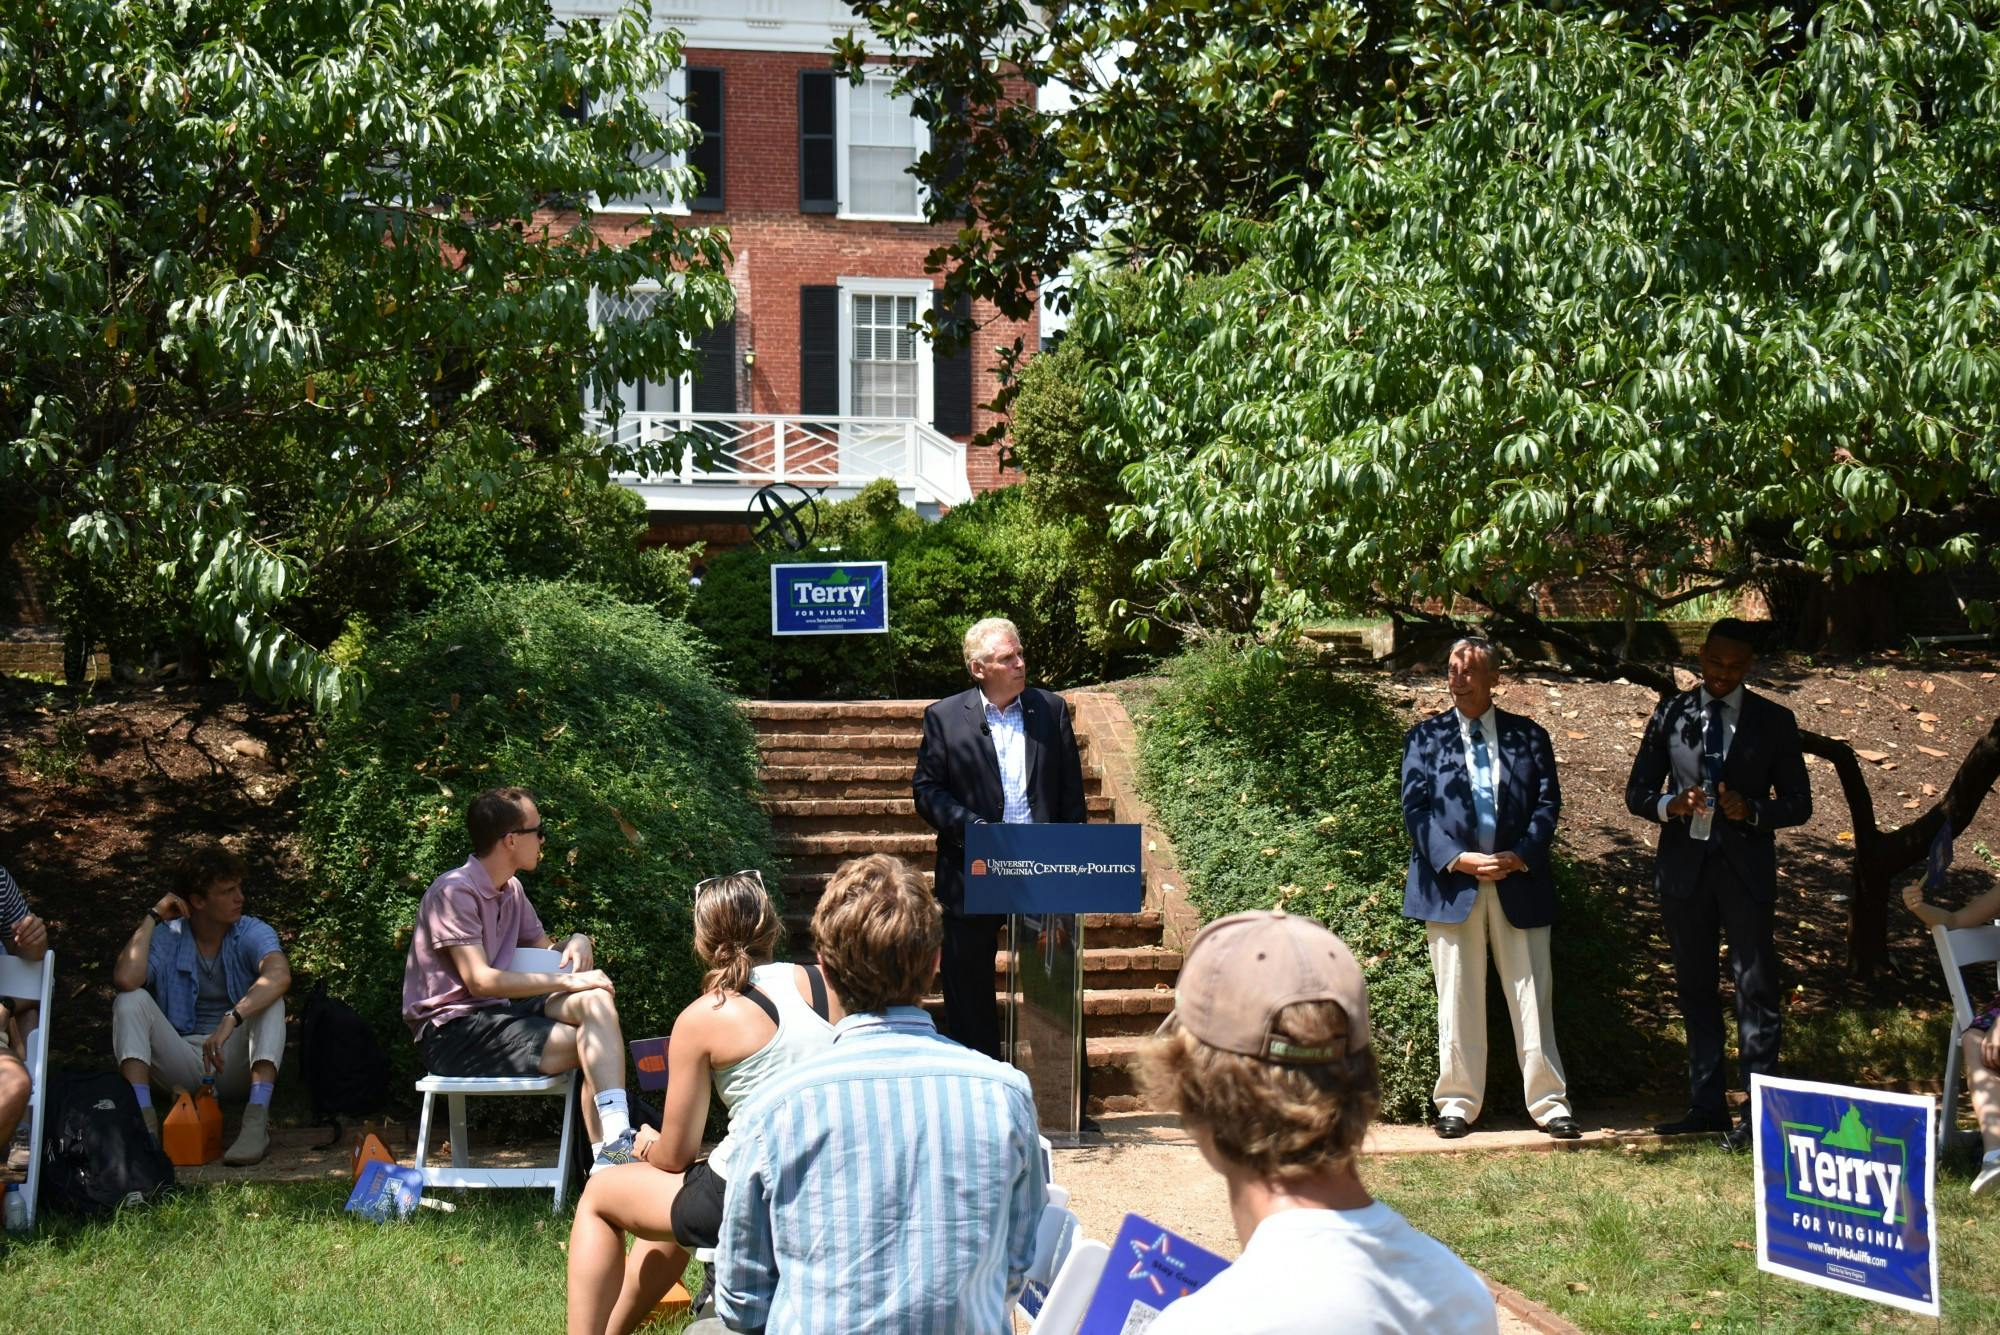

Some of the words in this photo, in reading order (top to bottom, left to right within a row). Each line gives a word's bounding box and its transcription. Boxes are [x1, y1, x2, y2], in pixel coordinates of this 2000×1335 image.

[794, 583, 866, 608] Terry
[987, 859, 1035, 868] UNIVERSITY
[996, 867, 1034, 876] VIRGINIA
[1033, 863, 1077, 875] CENTER
[1076, 866, 1088, 876] for
[1087, 863, 1136, 875] POLITICS
[1788, 1134, 1902, 1225] Terry
[1792, 1212, 1821, 1233] FOR
[1828, 1222, 1904, 1250] VIRGINIA
[1806, 1241, 1888, 1268] www.TerryMcAuliffe.com
[1153, 1260, 1173, 1277] Stay
